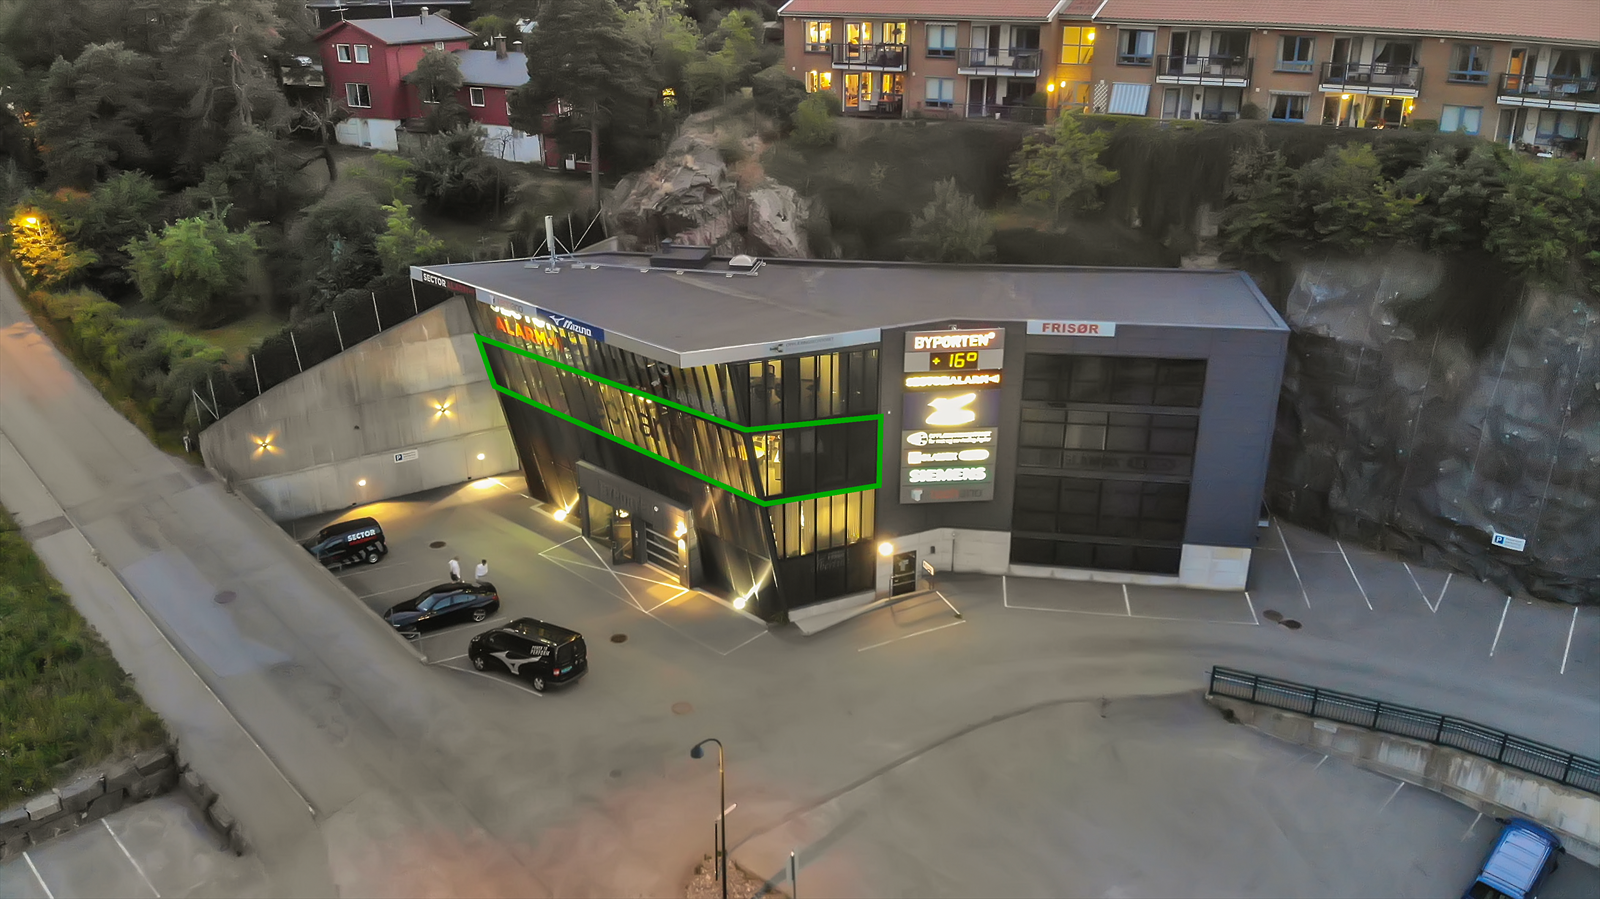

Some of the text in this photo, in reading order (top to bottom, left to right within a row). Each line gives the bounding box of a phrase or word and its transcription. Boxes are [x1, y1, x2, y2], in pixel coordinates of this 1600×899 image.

[423, 273, 447, 287] SECTOR
[1042, 323, 1099, 334] FRISØR
[347, 528, 376, 542] SECTOR
